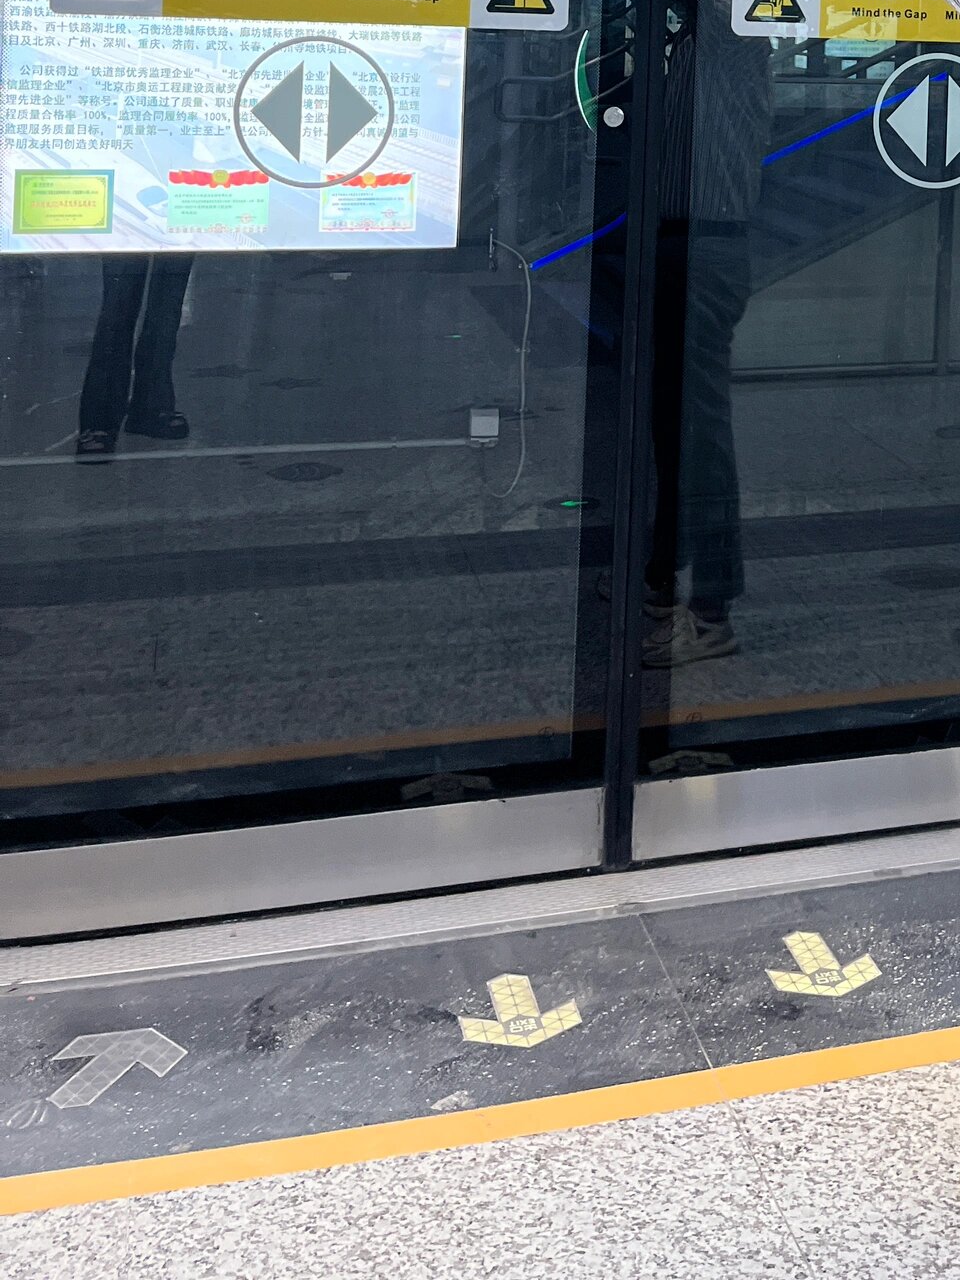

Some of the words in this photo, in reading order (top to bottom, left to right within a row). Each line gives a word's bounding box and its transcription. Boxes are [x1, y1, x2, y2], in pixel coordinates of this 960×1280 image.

[852, 7, 880, 18] Mind
[883, 8, 901, 18] the
[904, 10, 927, 20] Gap
[4, 138, 133, 150] 界朋友共同创造美好明天
